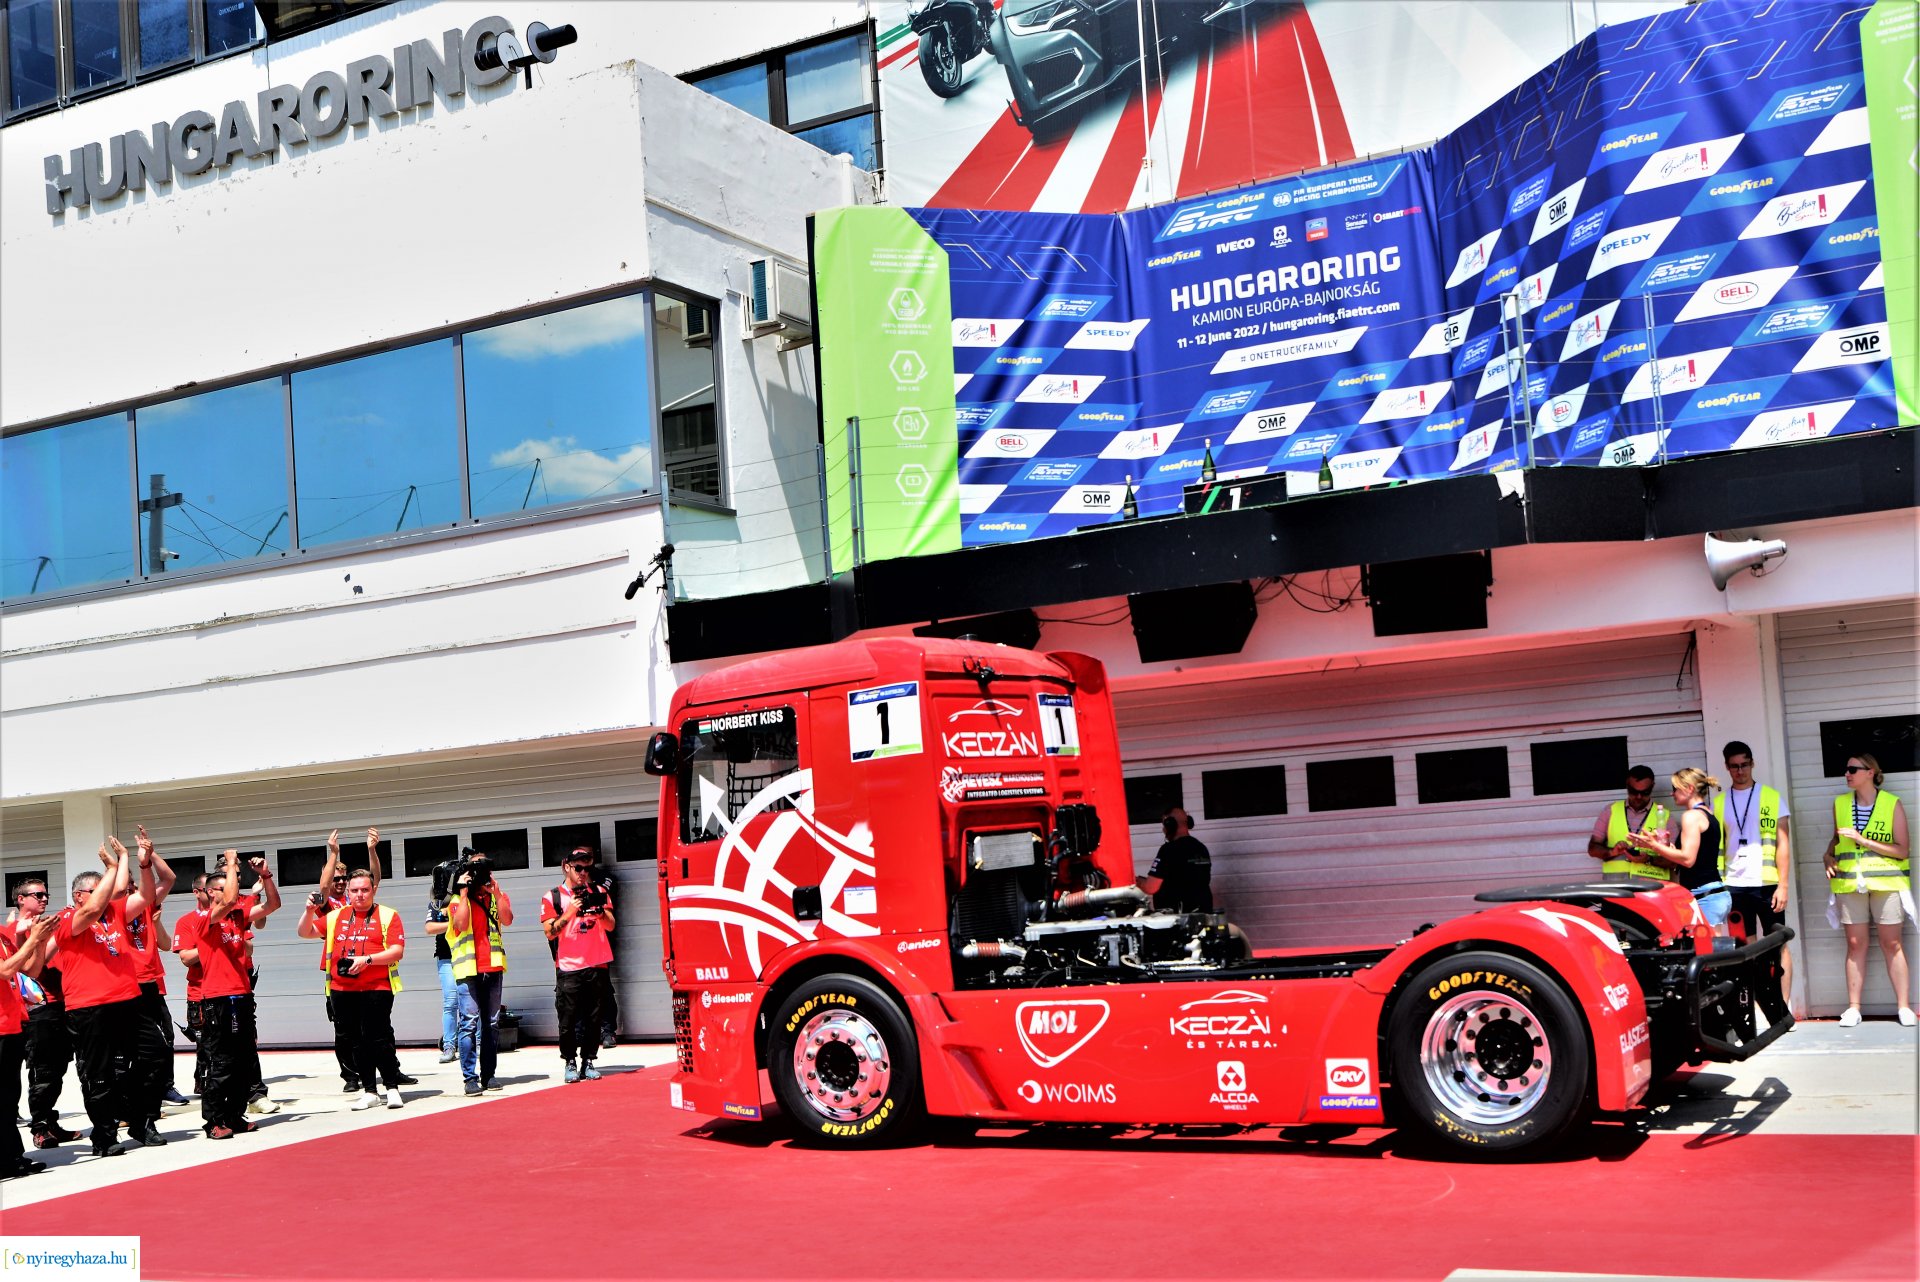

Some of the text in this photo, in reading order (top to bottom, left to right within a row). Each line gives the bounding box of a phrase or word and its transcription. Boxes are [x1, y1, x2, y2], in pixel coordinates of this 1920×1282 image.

[44, 15, 516, 215] HUNGARORING
[1601, 131, 1658, 153] GOODYEAR
[1293, 181, 1378, 204] RACING CHAMPIONSHIP
[1306, 180, 1347, 193] EUROPEAN
[1348, 175, 1373, 185] TRUCK
[1710, 177, 1773, 197] GOODYEAR
[1216, 192, 1266, 209] GOODYEAR
[1549, 201, 1567, 220] OMP
[1601, 233, 1651, 255] SPEEDY
[1829, 226, 1880, 245] GOODYE
[1216, 237, 1256, 255] IVECO
[1147, 249, 1202, 268] GOODYEAR
[1171, 245, 1401, 312] HUNGARORING
[1720, 285, 1753, 299] BELL
[1192, 280, 1381, 327] KAMION EURÓPA-BAJNOKSÁG
[1086, 329, 1131, 337] SPEEDY
[1177, 337, 1188, 349] 11
[1195, 334, 1207, 345] 12
[1233, 325, 1260, 338] 2022
[1269, 302, 1401, 331] hungaroring.fiaetrc.com
[1602, 342, 1647, 362] GOODYEAR
[1840, 335, 1880, 354] OMP
[996, 355, 1043, 365] GOODYEAR
[1337, 373, 1386, 387] GOODYEAR
[1697, 392, 1761, 409] GOODYEAR
[1078, 411, 1125, 422] GOODYEAR
[1257, 416, 1286, 430] OMP
[1000, 438, 1024, 446] BELL
[1333, 457, 1382, 471] SPEEDY
[1613, 447, 1636, 464] OMP
[1082, 494, 1111, 505] OMP
[978, 521, 1027, 531] GOODYEAR
[711, 710, 784, 732] NORBERT KISS
[876, 702, 890, 745] 1
[1054, 708, 1066, 745] 1
[1760, 818, 1776, 828] OTO
[1874, 821, 1886, 831] 72
[1866, 831, 1892, 842] FOTO
[695, 967, 729, 980] BALU
[785, 993, 857, 1032] GOODYEAR
[1028, 1009, 1078, 1035] MOL
[1332, 1069, 1365, 1083] DKV
[1043, 1082, 1116, 1104] WOIMS
[1209, 1092, 1259, 1104] ALCOA
[1321, 1096, 1377, 1108] GOODYEAR
[821, 1098, 894, 1136] GOODYEAR
